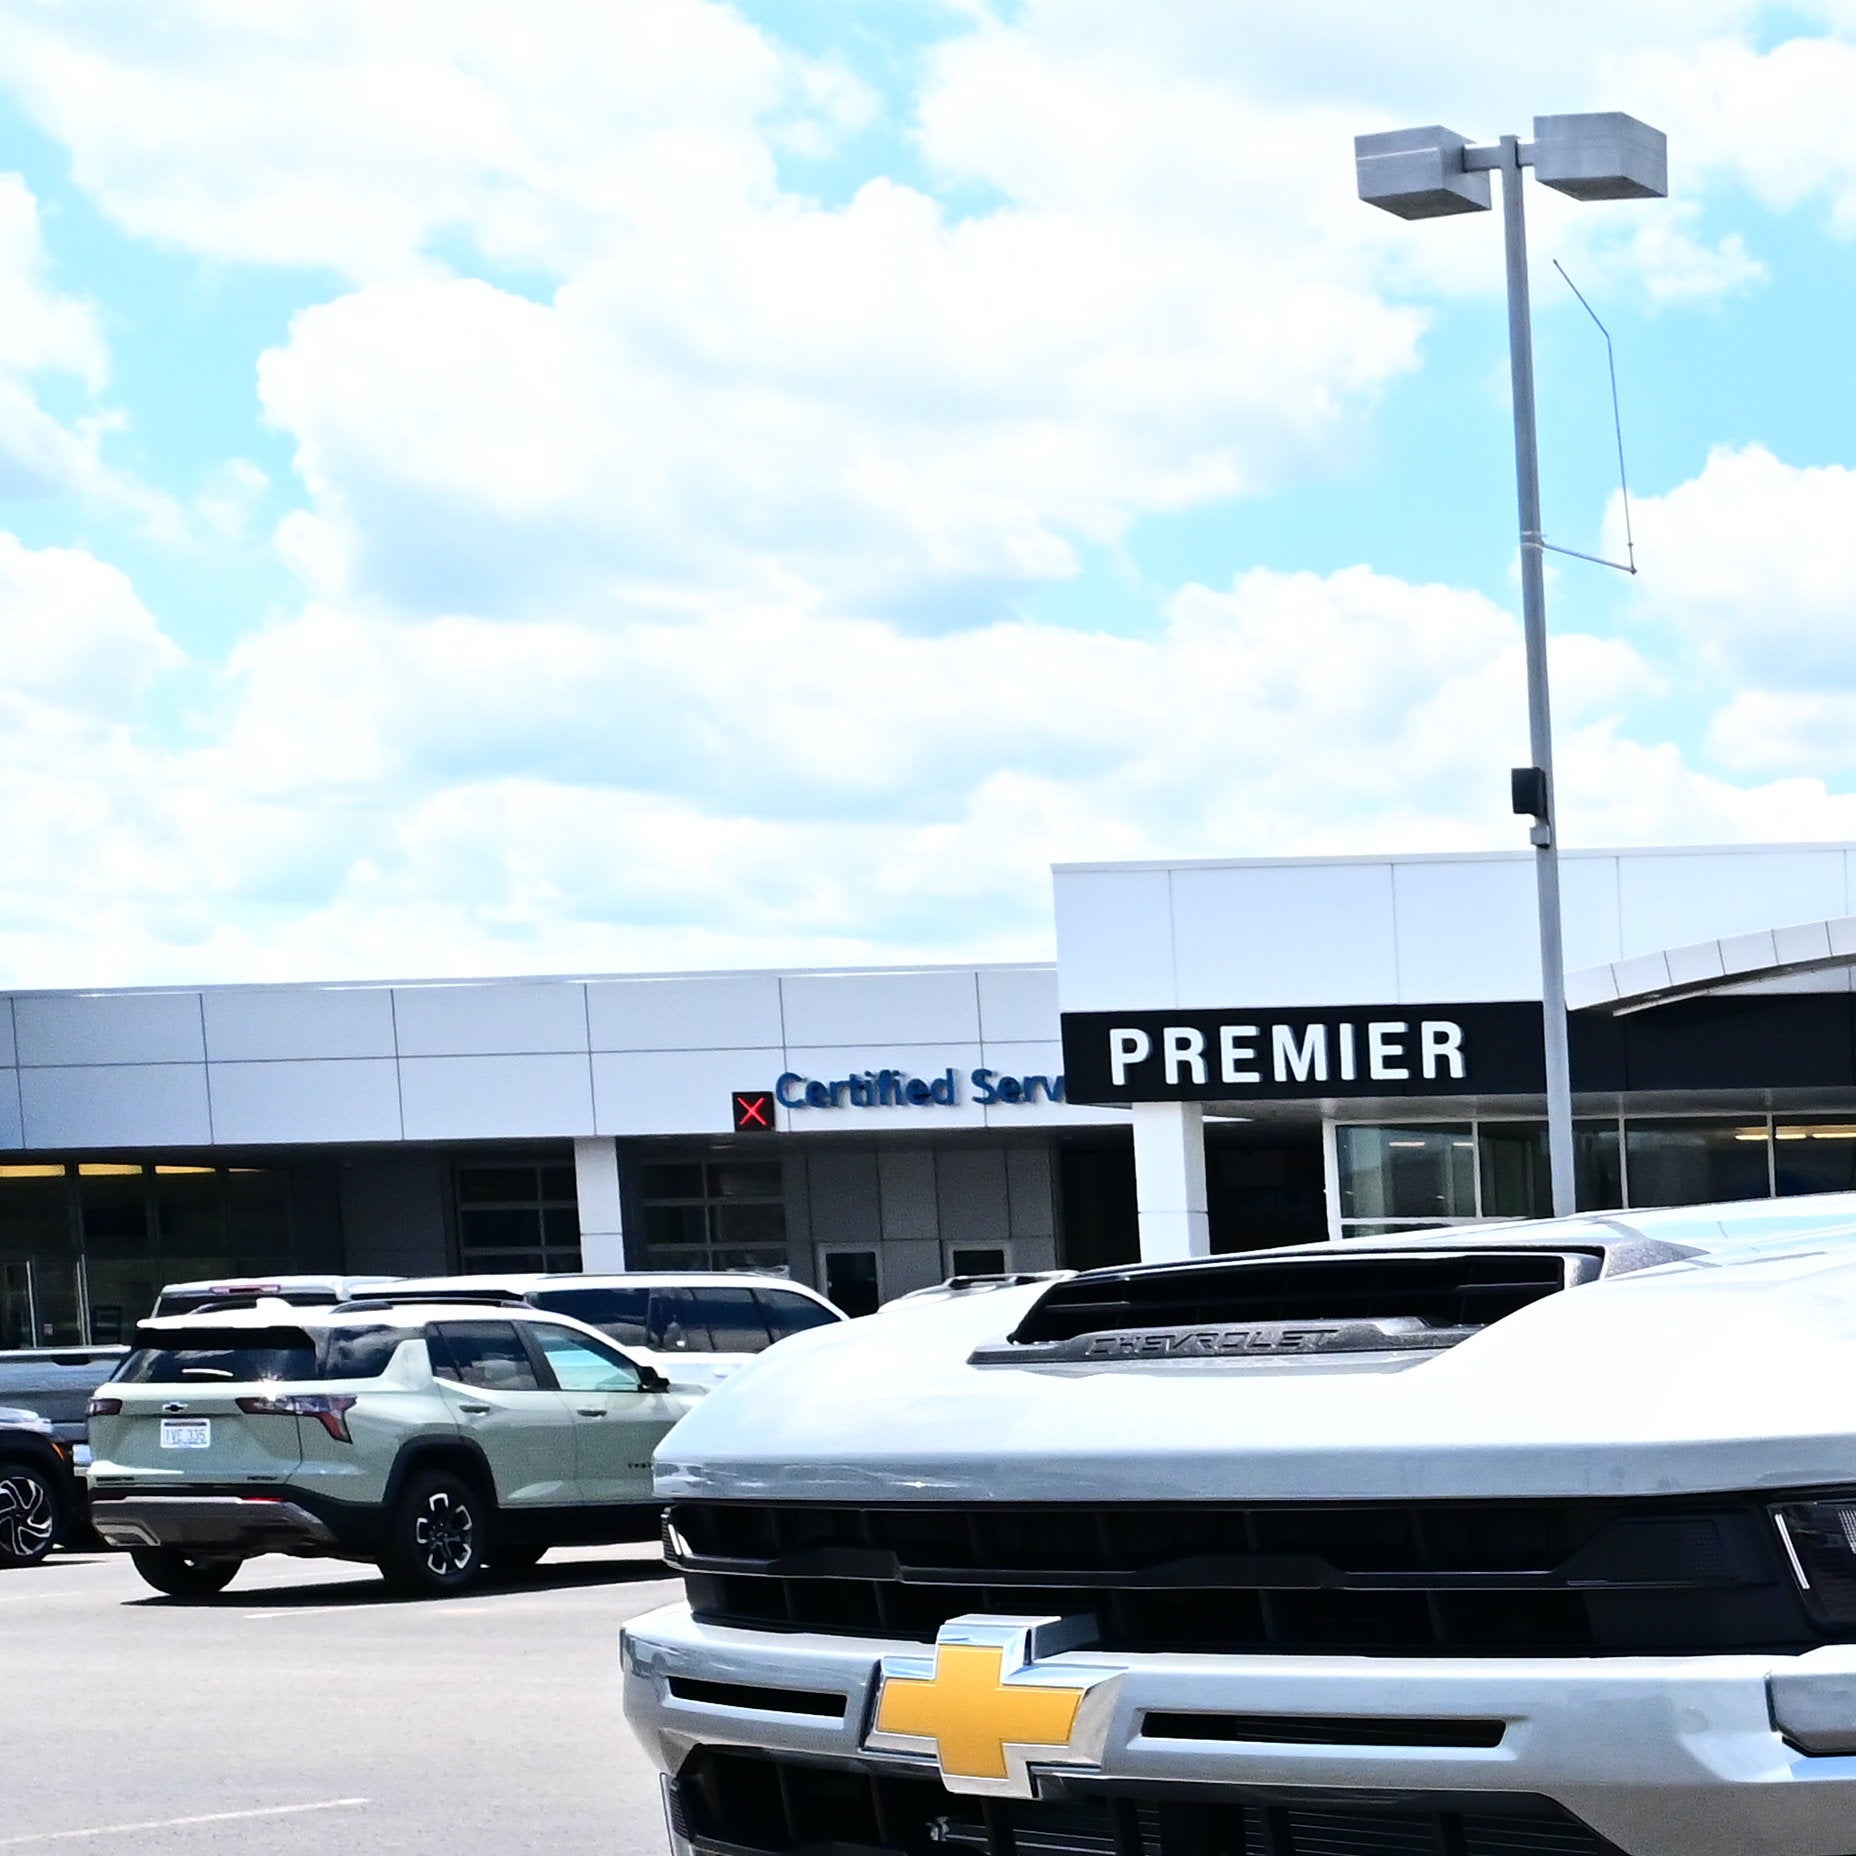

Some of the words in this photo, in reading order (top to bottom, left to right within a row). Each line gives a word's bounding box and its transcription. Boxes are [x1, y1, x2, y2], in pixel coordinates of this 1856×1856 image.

[1108, 1020, 1467, 1086] PREMIER
[775, 1067, 958, 1109] Certified
[1084, 1329, 1339, 1356] CHEVROLET
